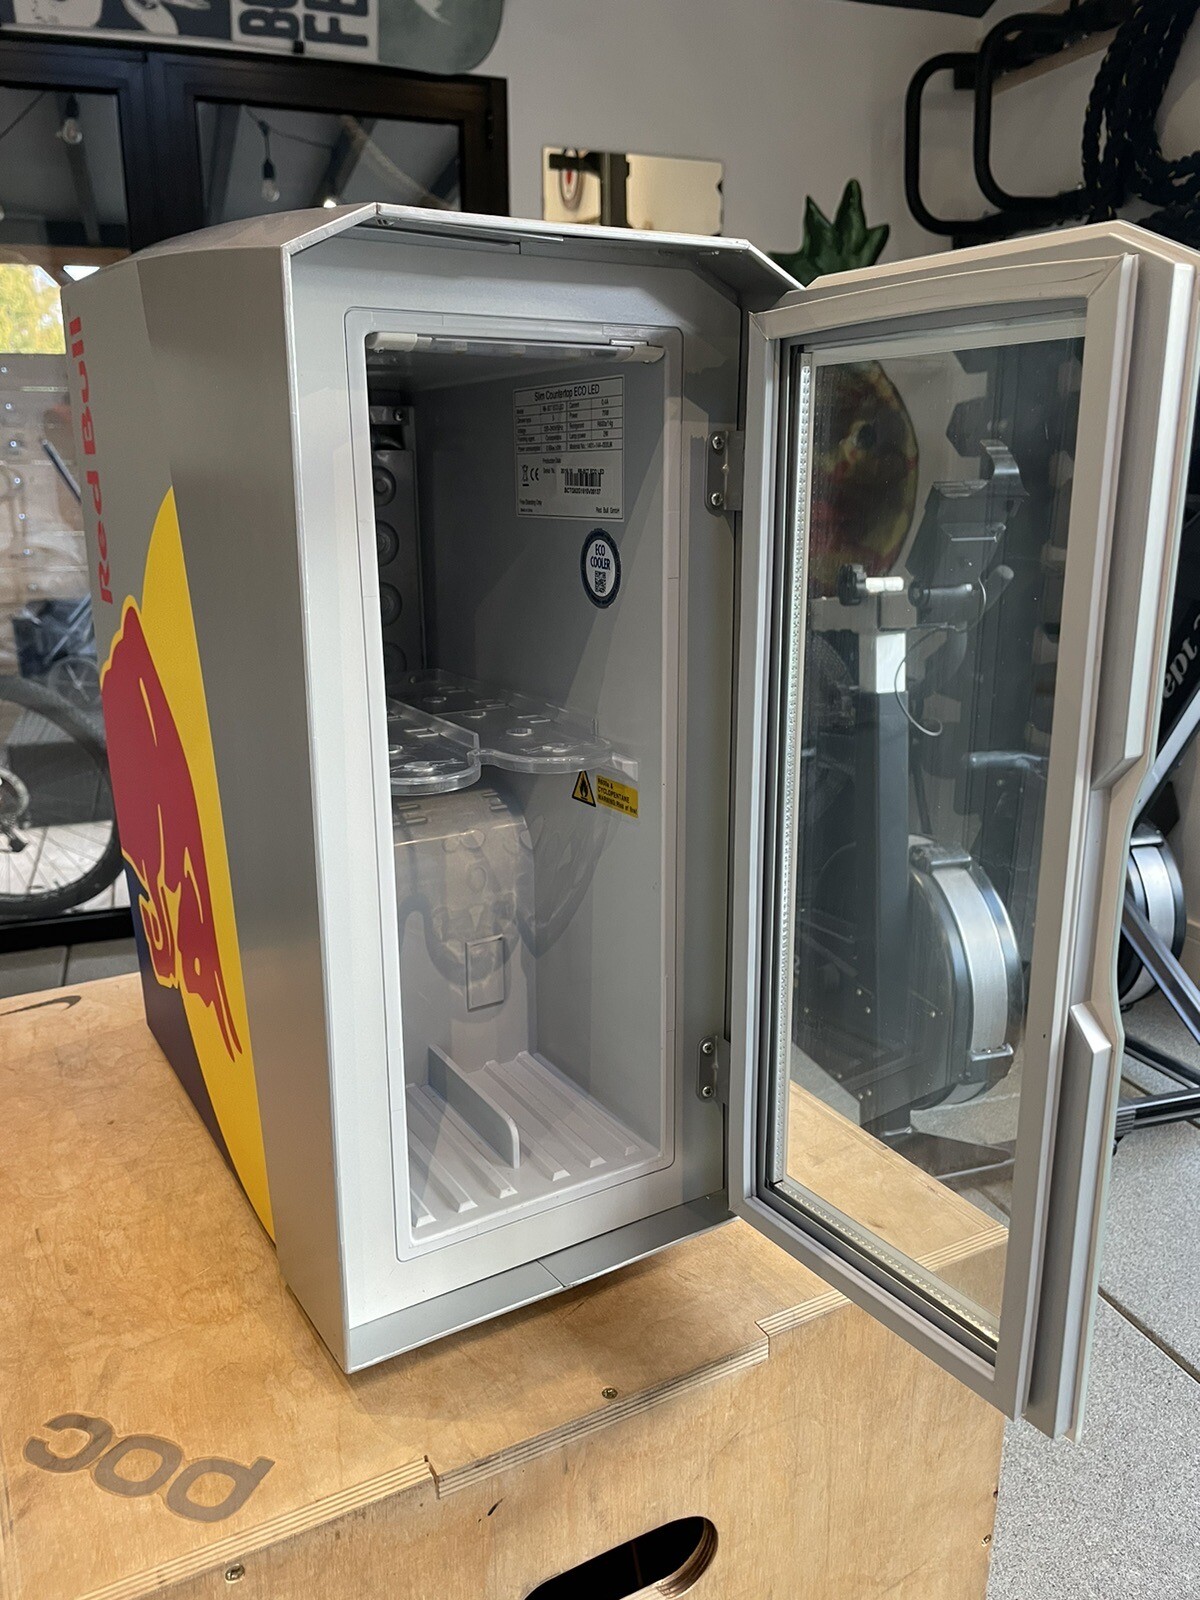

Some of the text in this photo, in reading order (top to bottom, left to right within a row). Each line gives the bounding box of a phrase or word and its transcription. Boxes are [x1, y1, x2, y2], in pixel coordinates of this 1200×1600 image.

[534, 383, 600, 402] Slim Countertop ECO LED
[69, 316, 113, 605] Red Bull
[594, 543, 606, 557] ECO
[590, 556, 611, 571] COOLER
